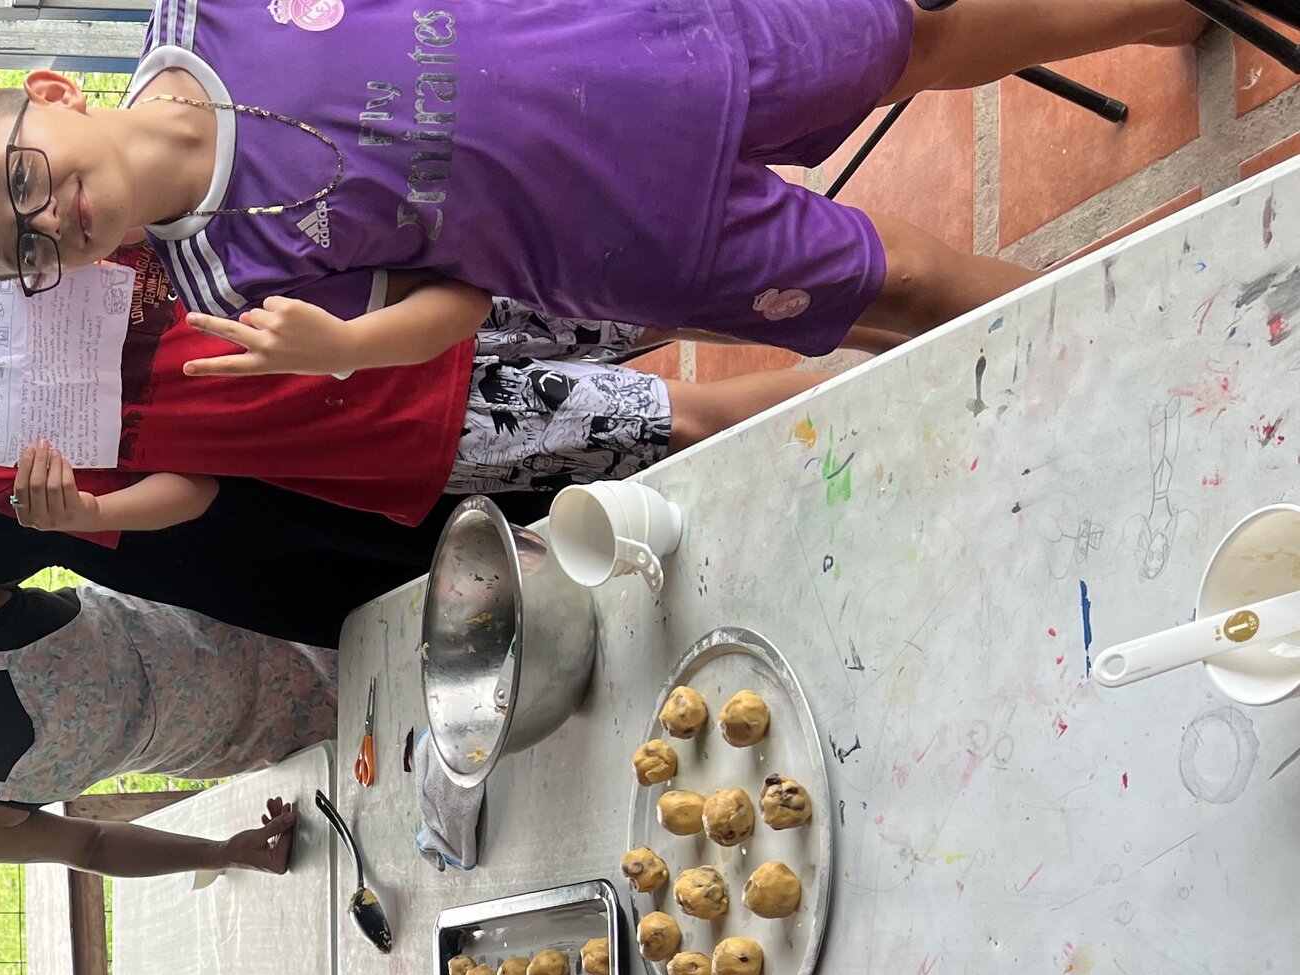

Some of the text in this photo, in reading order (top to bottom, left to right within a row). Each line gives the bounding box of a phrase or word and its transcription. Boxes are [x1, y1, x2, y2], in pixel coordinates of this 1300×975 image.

[358, 80, 401, 146] Fly
[397, 9, 459, 241] Emirates
[313, 200, 332, 248] adidas
[1228, 622, 1249, 634] 1
[1248, 615, 1258, 631] TSP
